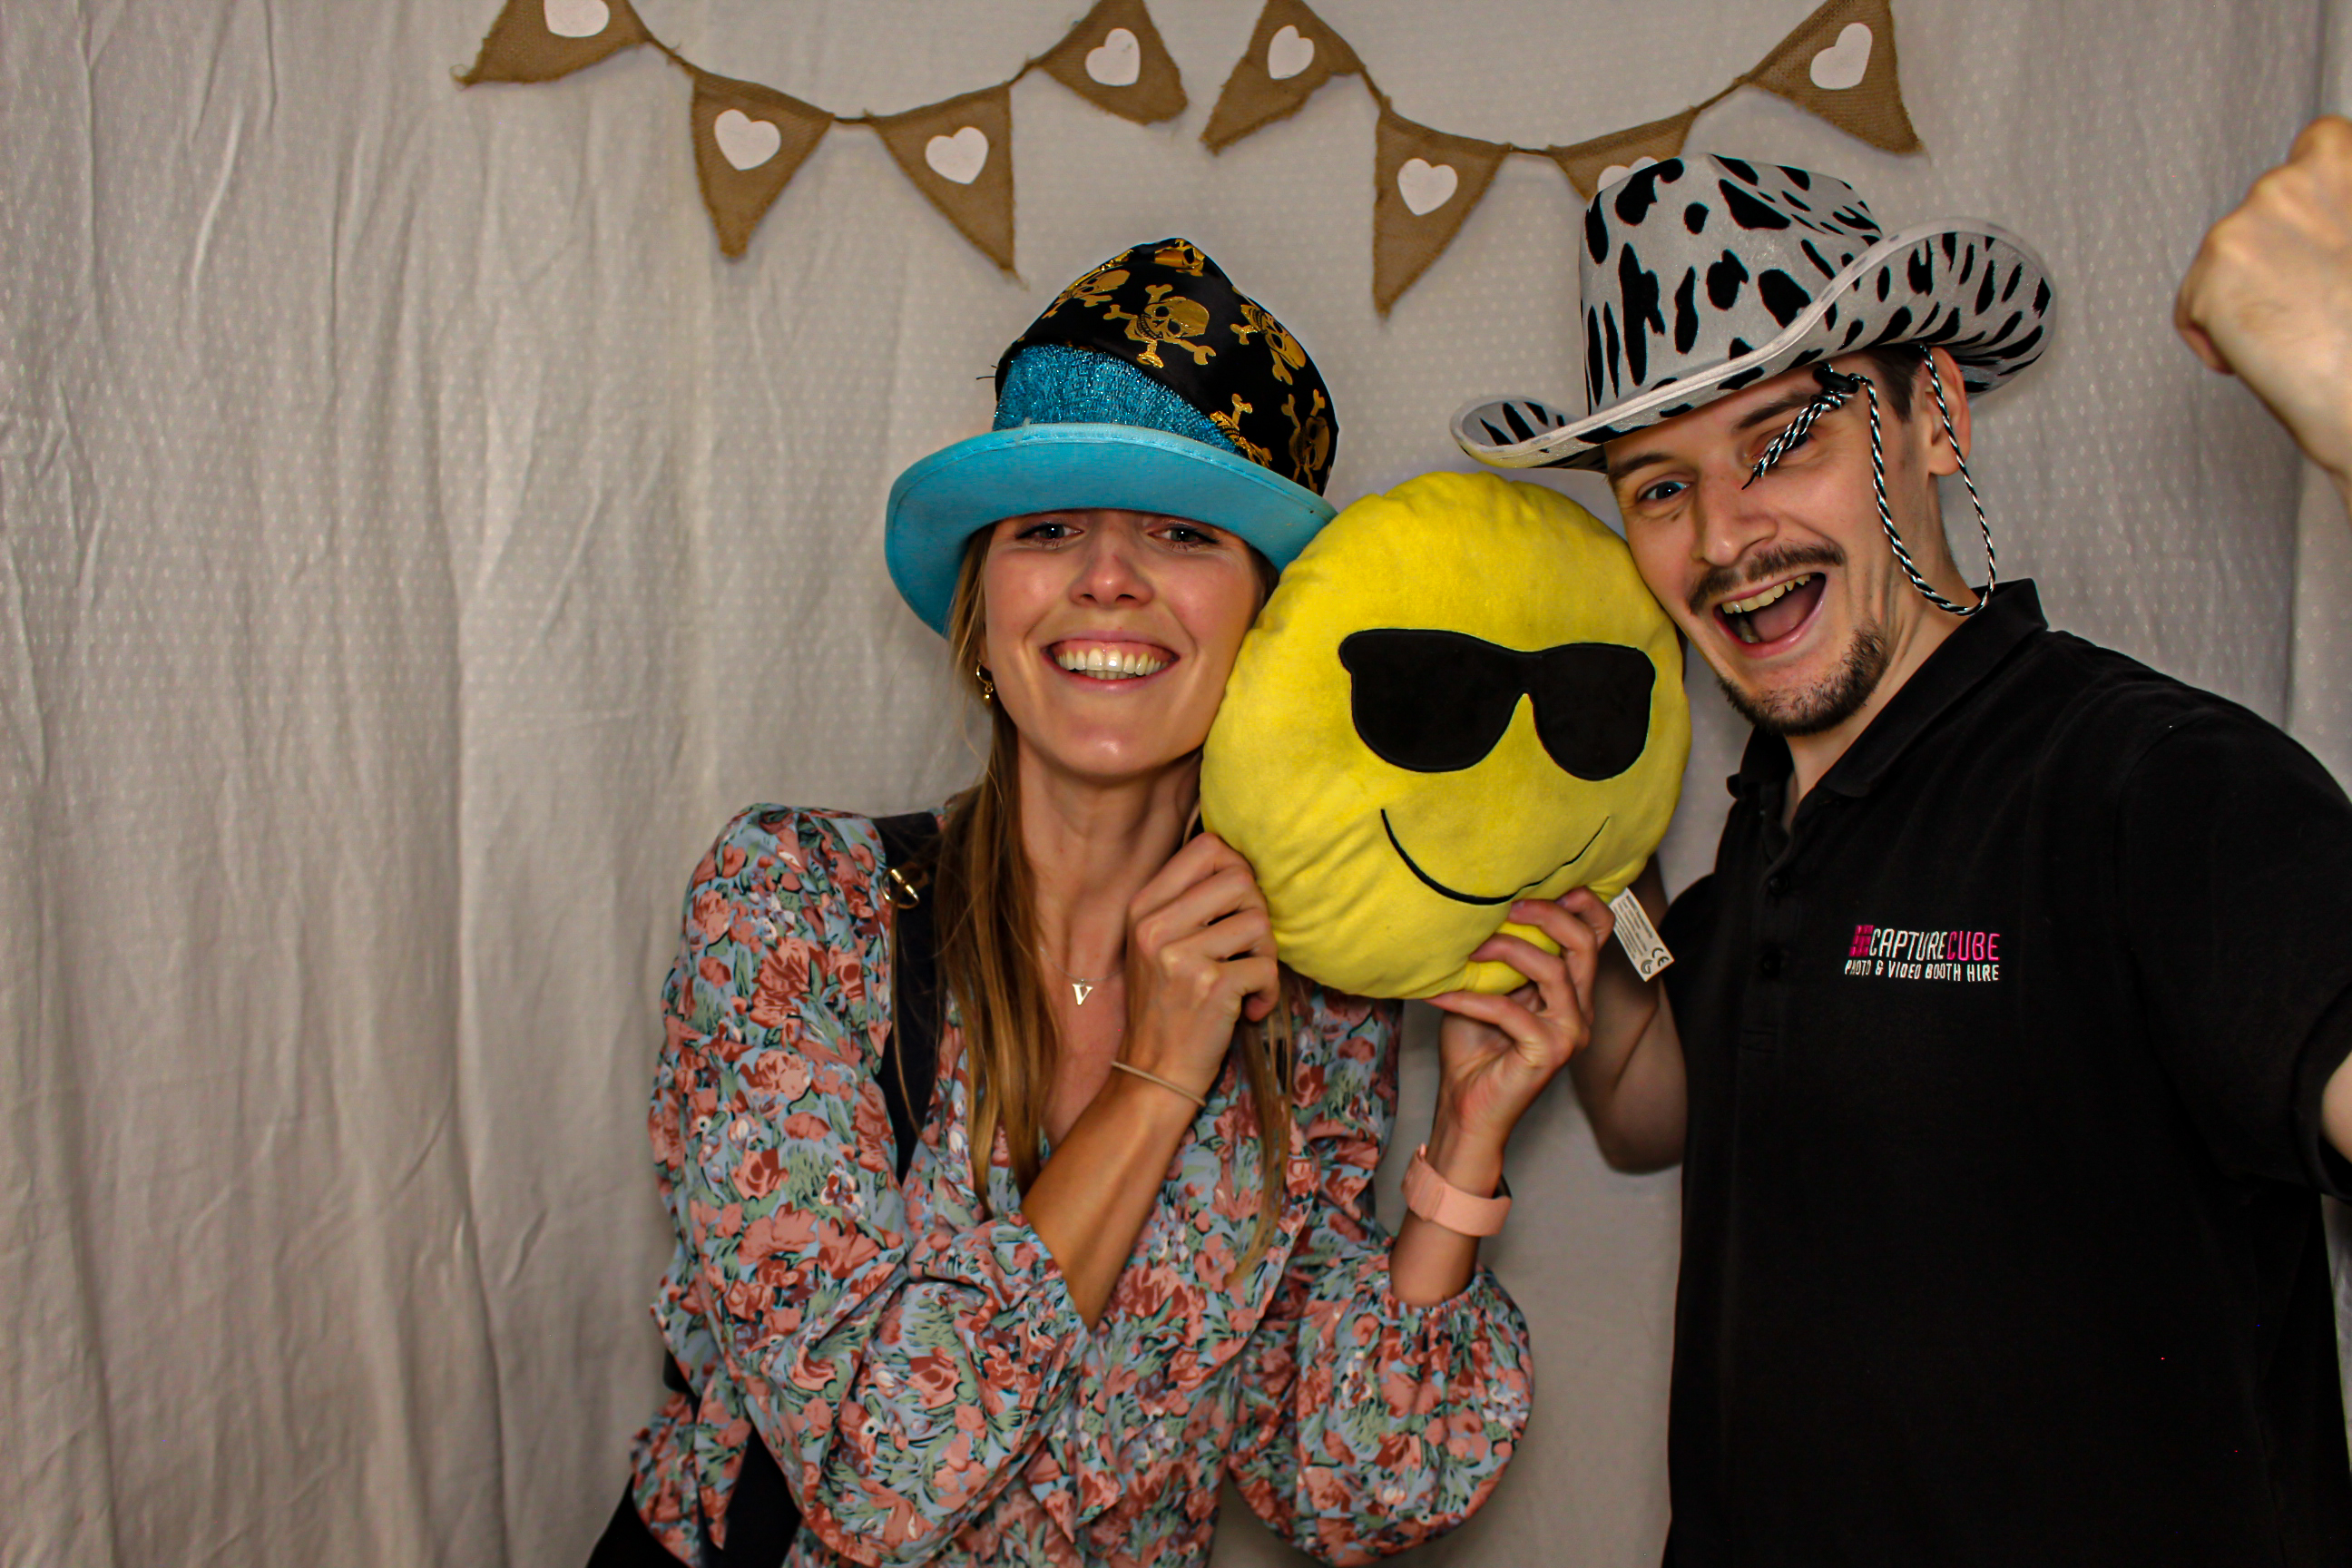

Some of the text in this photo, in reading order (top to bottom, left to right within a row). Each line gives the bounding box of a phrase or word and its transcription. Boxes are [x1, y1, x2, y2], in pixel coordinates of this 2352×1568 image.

[1870, 928, 2000, 961] CAPTURECUBE
[1845, 960, 2000, 982] PHOTO & VIDEO BOOTH HIRE
[1072, 984, 1093, 1005] V
